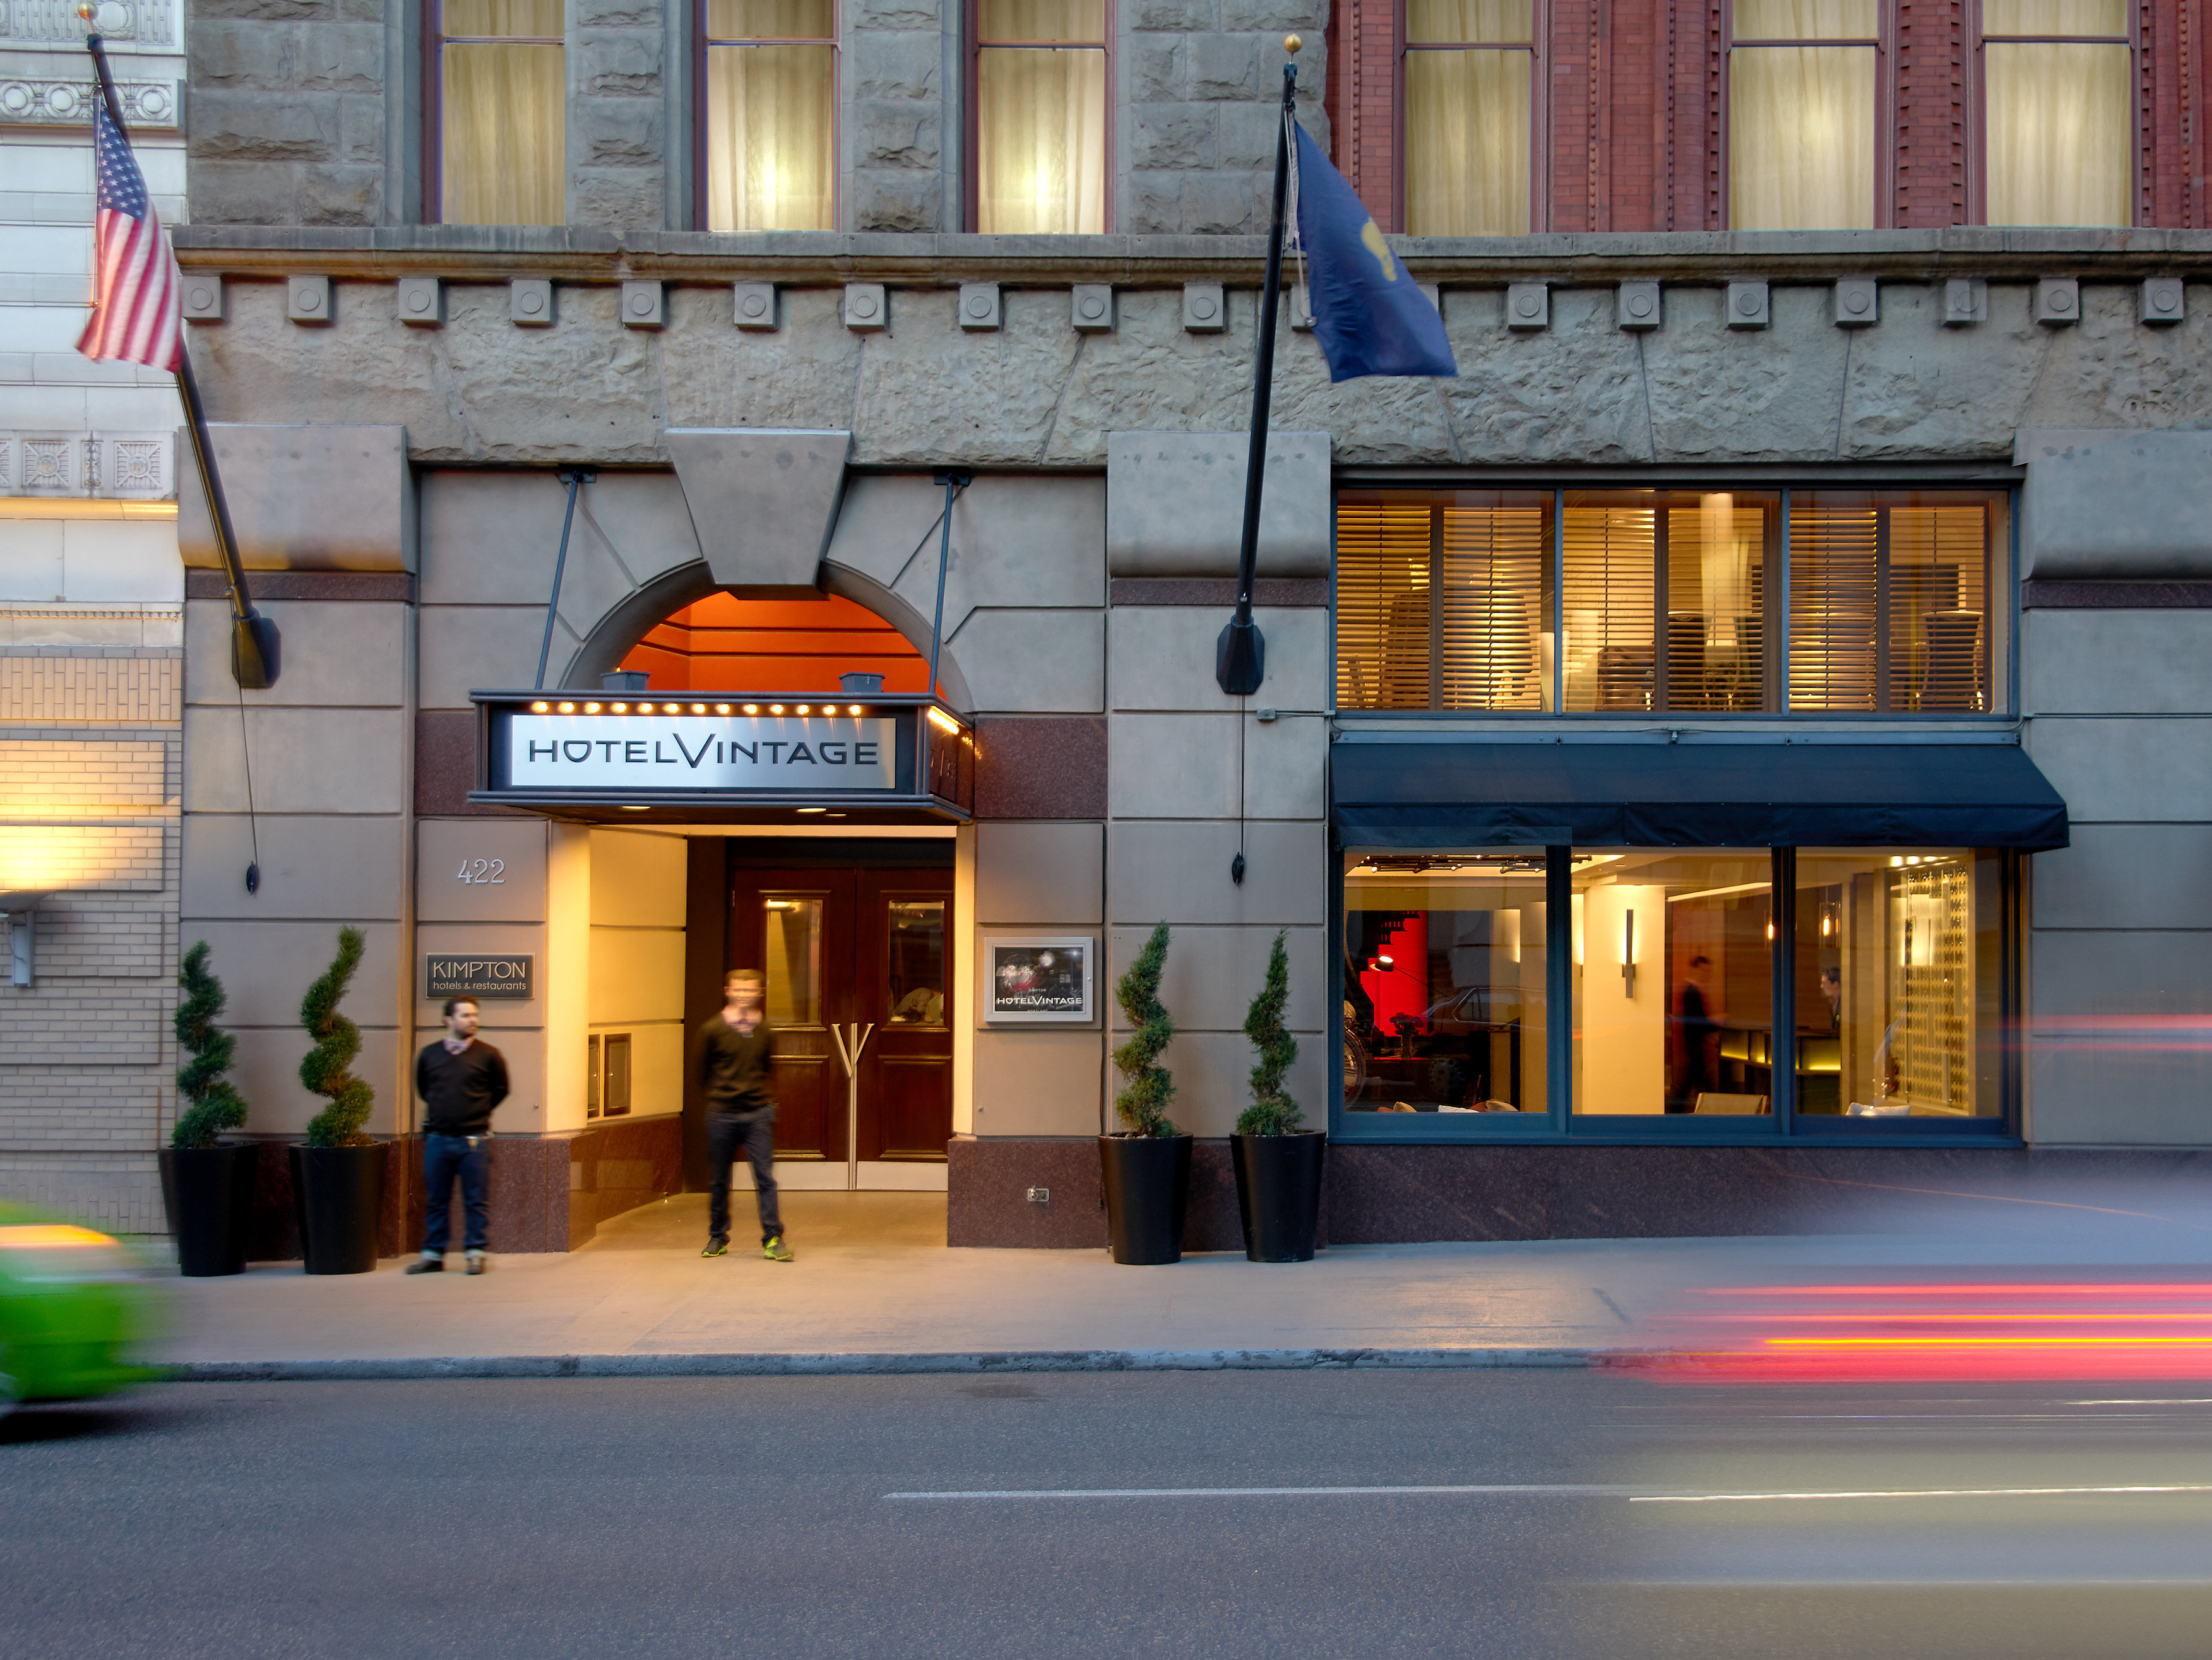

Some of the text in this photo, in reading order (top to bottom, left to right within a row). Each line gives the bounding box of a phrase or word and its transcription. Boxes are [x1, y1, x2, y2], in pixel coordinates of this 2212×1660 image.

[458, 859, 506, 884] 422
[434, 961, 526, 978] KIMPTON
[433, 981, 462, 990] hotels
[473, 981, 526, 990] restaurants
